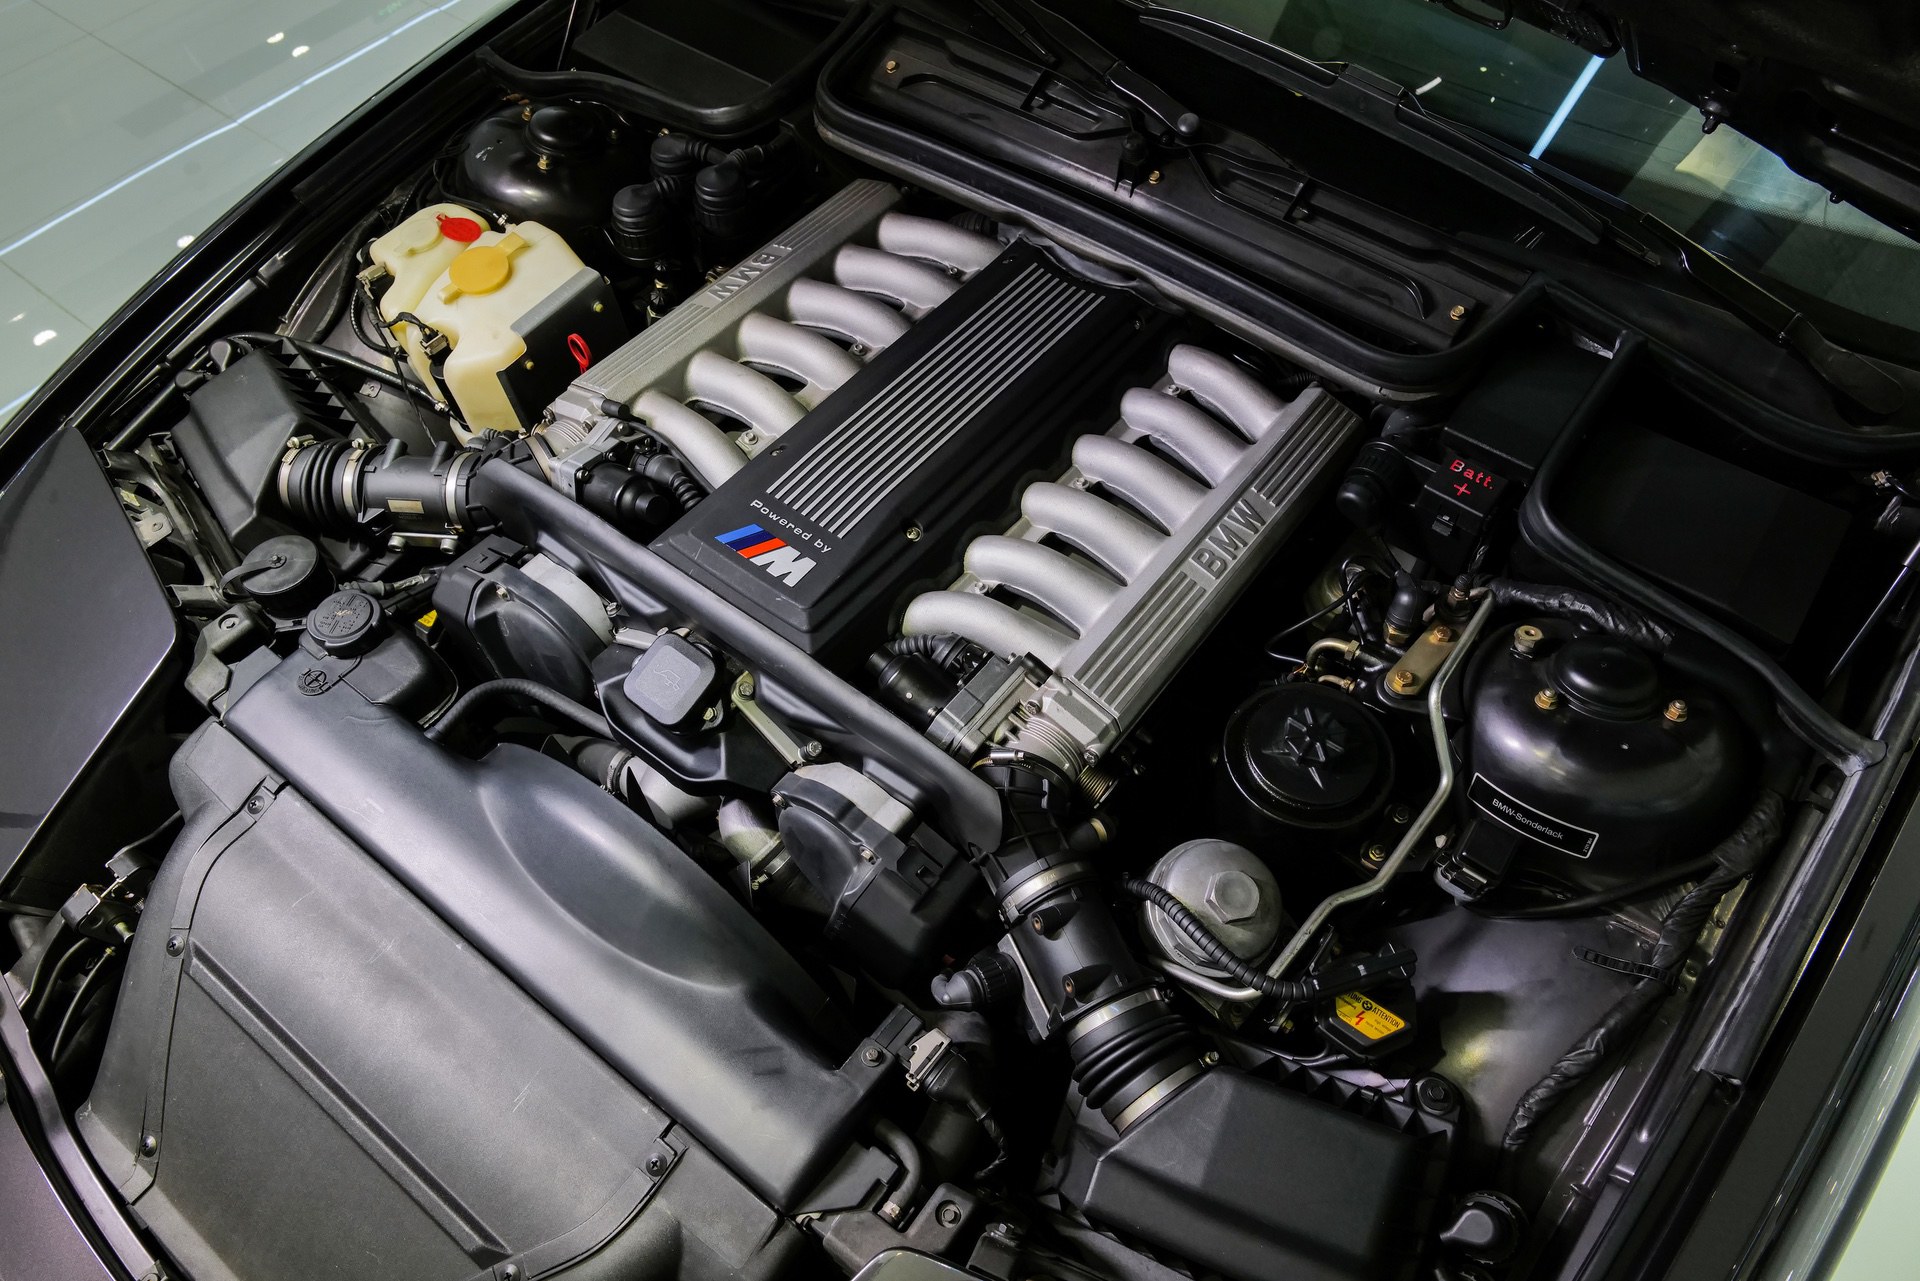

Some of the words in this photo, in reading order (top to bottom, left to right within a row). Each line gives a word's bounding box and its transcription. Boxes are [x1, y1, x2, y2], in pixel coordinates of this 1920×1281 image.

[706, 252, 782, 302] BMW
[1449, 458, 1494, 490] Batt.
[749, 499, 813, 541] Powered
[814, 538, 833, 554] by
[1188, 497, 1267, 580] BMW
[749, 545, 817, 588] M
[1492, 798, 1564, 840] BMW-Sonderlack
[1371, 1006, 1401, 1028] ATTENTION
